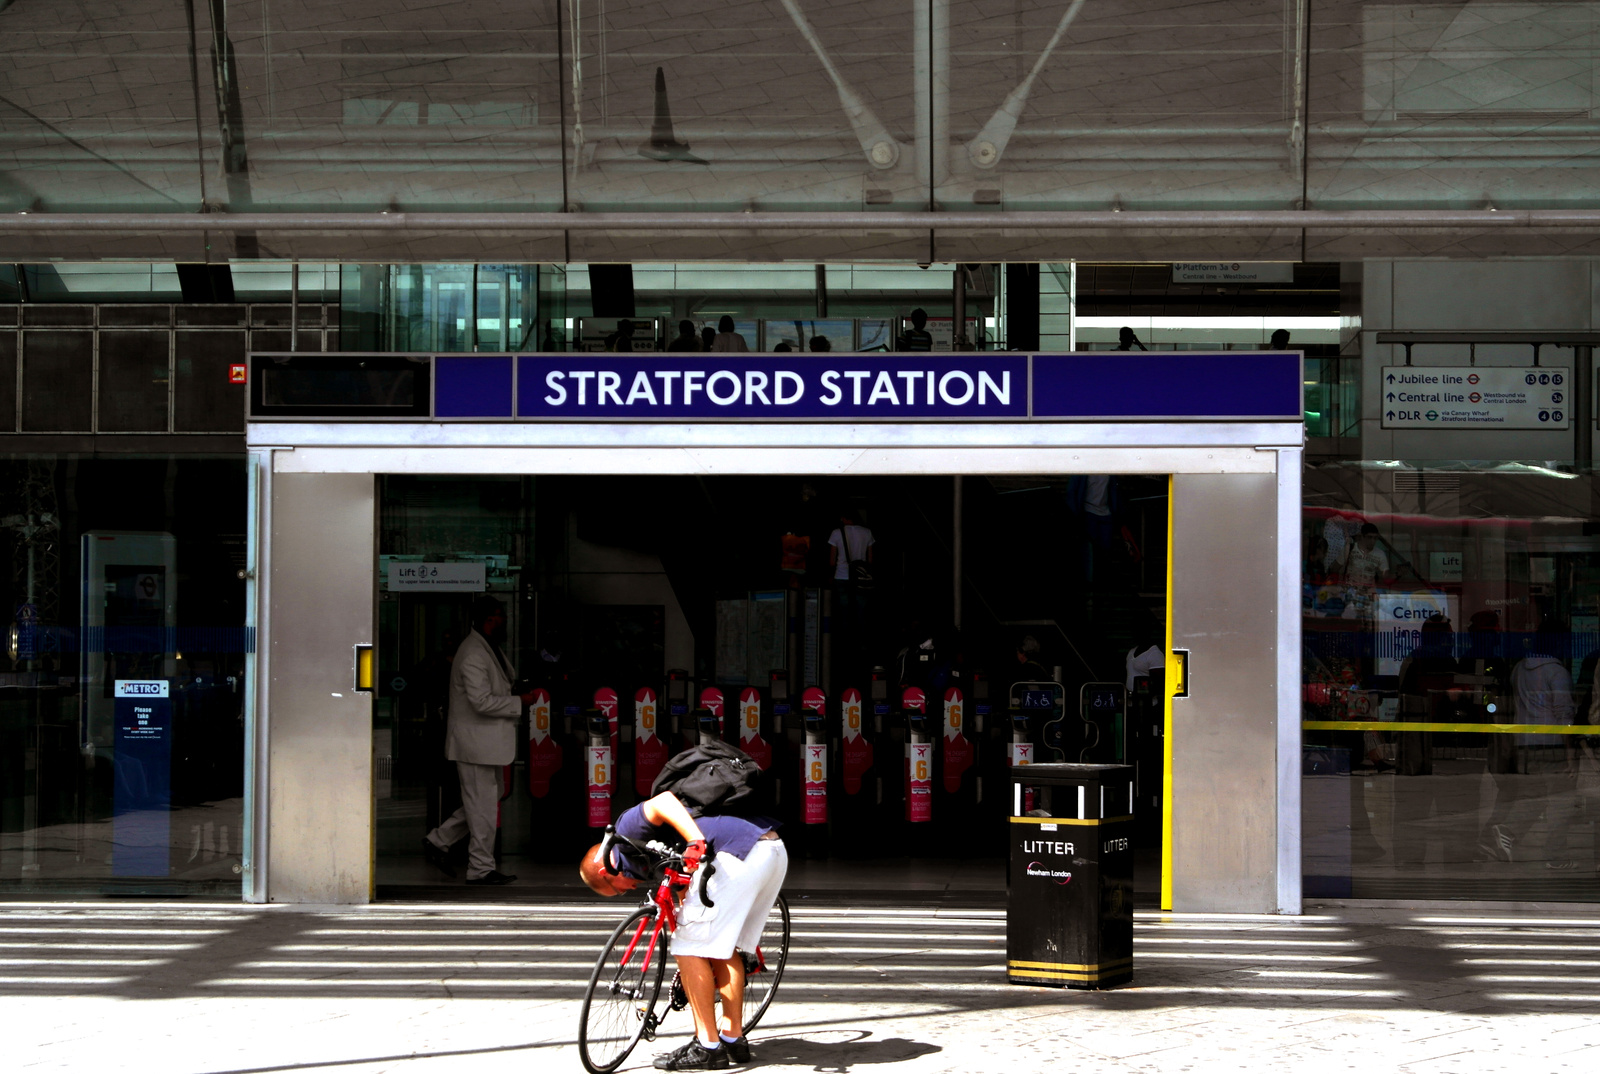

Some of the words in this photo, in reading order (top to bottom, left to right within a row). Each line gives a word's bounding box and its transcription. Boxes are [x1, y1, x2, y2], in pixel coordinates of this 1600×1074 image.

[1183, 263, 1217, 271] Platform
[1220, 263, 1229, 271] 3a
[1398, 374, 1439, 384] Jubilee
[1442, 374, 1463, 384] line
[1526, 375, 1536, 384] 13
[1539, 375, 1549, 384] 14
[1552, 375, 1562, 384] 15
[543, 369, 805, 407] STRATFORD
[818, 369, 1012, 407] STATION
[1398, 392, 1440, 402] Central
[1444, 392, 1465, 402] line
[1398, 410, 1421, 420] DLR
[1552, 412, 1562, 421] 16
[1442, 557, 1460, 566] Lift
[399, 568, 416, 577] Lift
[125, 683, 160, 694] METRO
[536, 706, 549, 730] 6
[642, 705, 655, 729] 6
[746, 705, 758, 729] 6
[848, 705, 860, 729] 6
[949, 704, 961, 728] 6
[594, 763, 606, 784] 6
[811, 761, 823, 781] 6
[915, 760, 927, 780] 6
[1024, 840, 1075, 855] LITTER
[1104, 837, 1129, 854] LITTER
[1026, 868, 1051, 877] Newham
[1051, 869, 1072, 878] London
